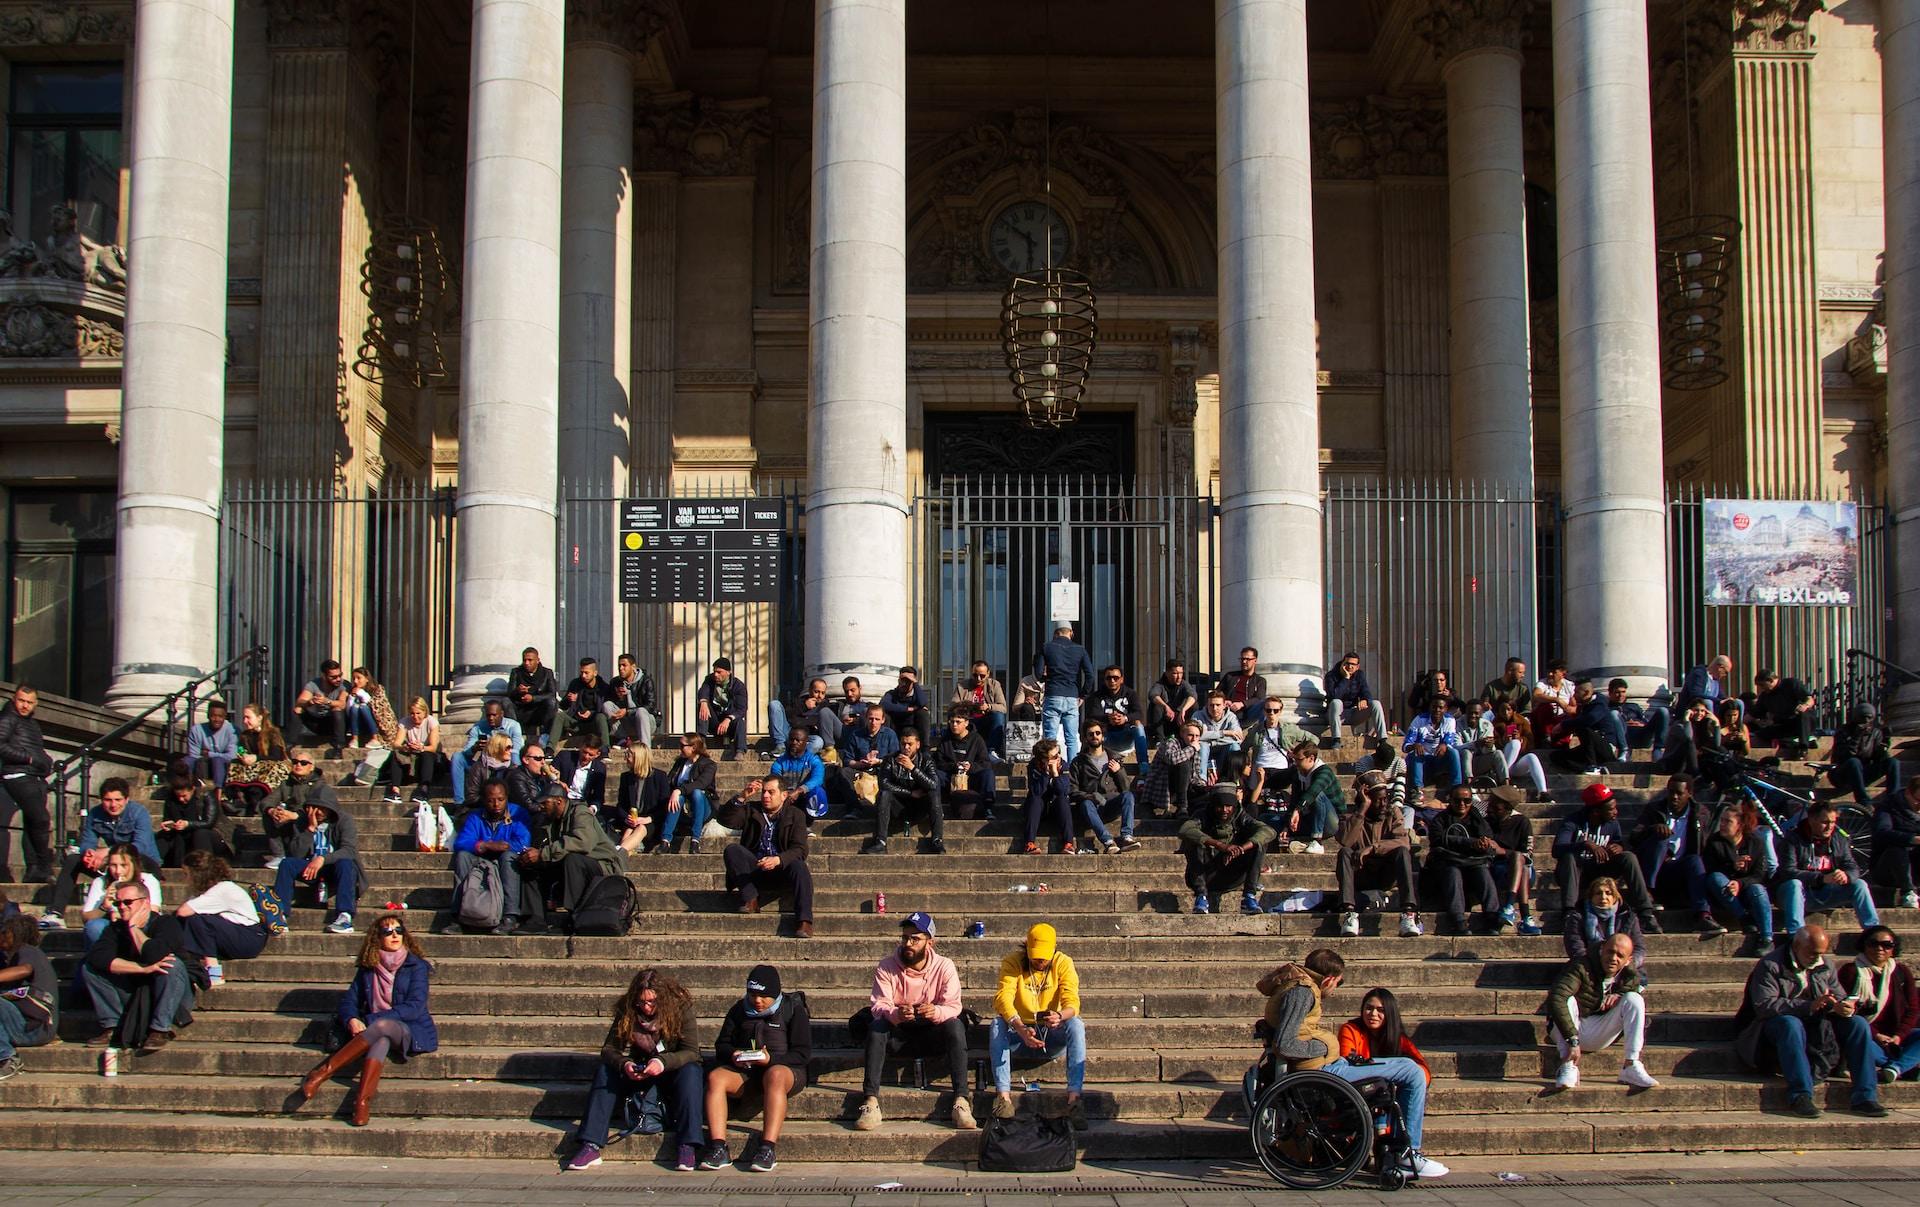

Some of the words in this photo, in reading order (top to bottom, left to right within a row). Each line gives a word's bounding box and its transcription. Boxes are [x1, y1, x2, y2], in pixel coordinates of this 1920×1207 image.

[678, 507, 693, 515] VAN
[697, 506, 714, 514] 10/10
[721, 506, 739, 514] 10/03
[675, 515, 695, 523] GOGH
[1759, 587, 1850, 604] #BXLove
